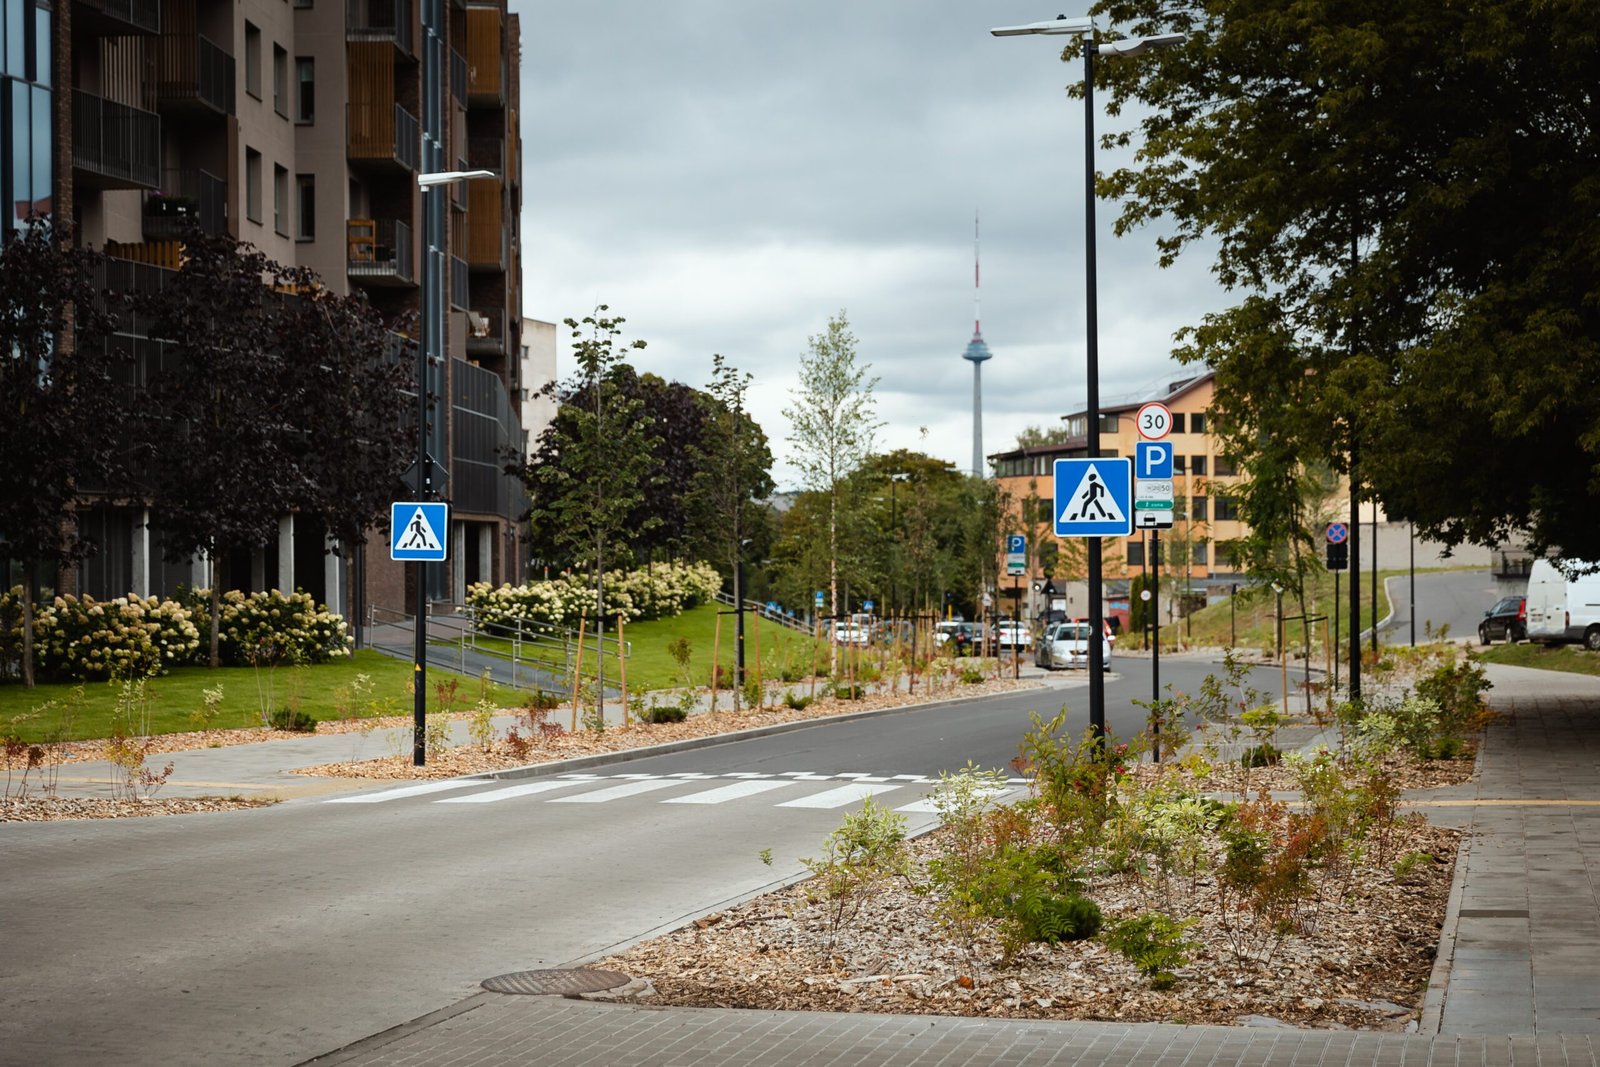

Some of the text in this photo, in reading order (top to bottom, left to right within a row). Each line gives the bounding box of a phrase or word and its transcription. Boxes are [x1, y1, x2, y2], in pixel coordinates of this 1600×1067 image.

[1144, 414, 1164, 429] 30
[1145, 446, 1167, 475] P
[1011, 537, 1022, 552] P
